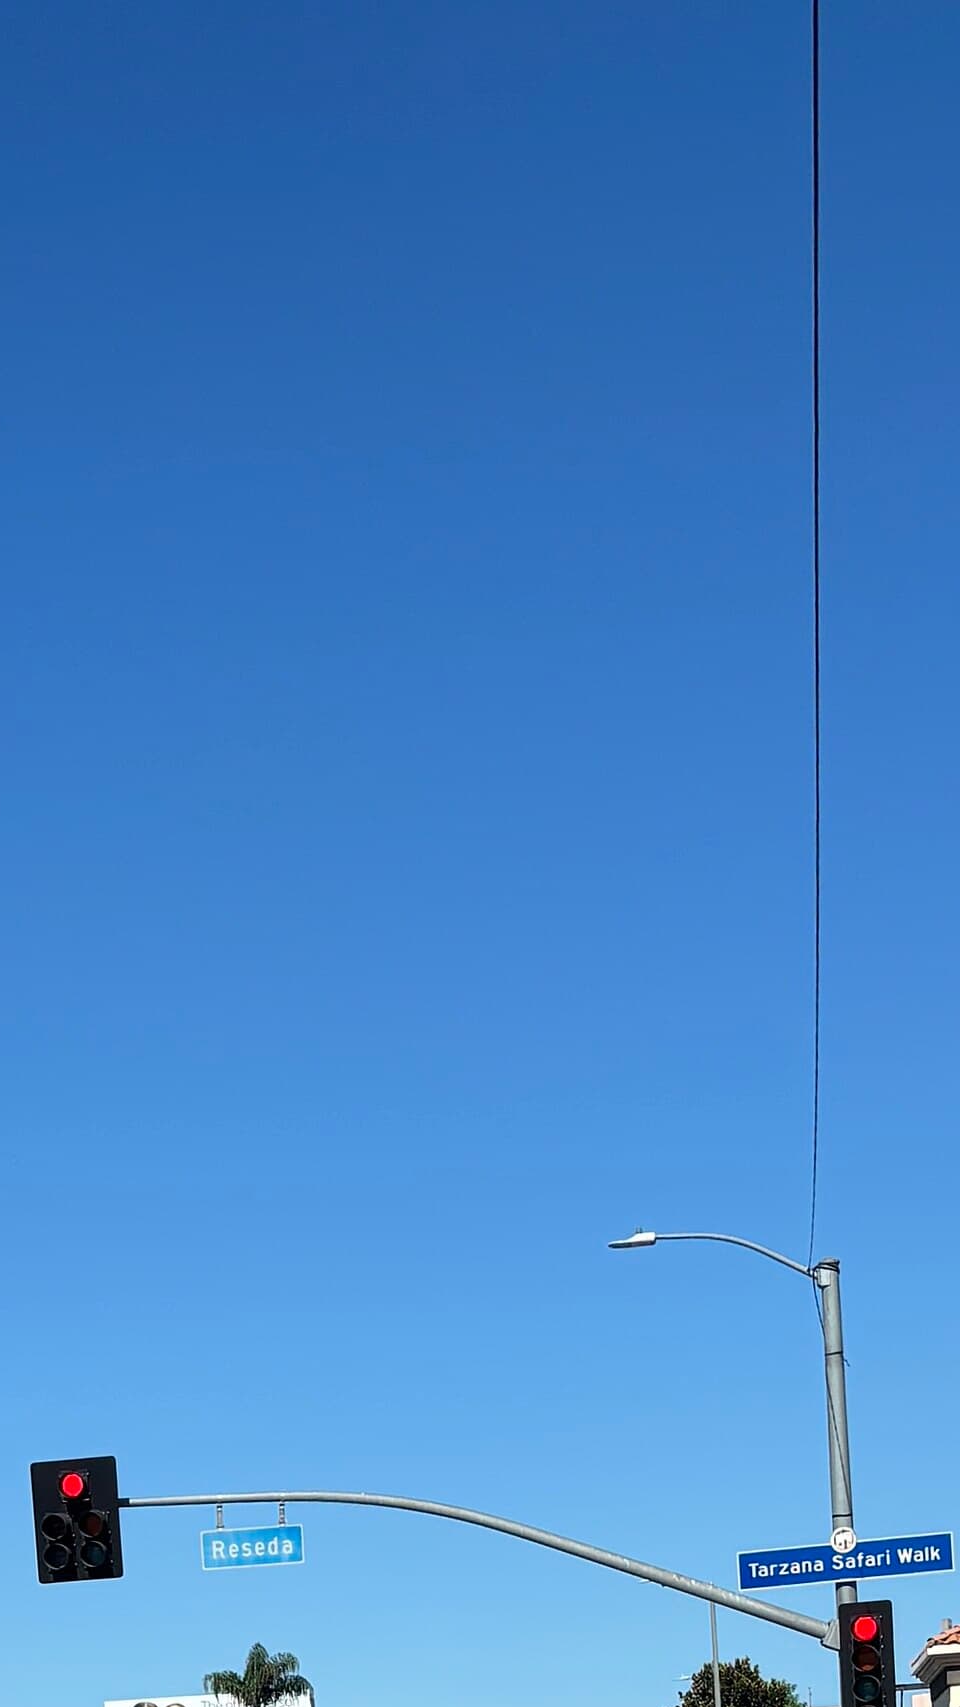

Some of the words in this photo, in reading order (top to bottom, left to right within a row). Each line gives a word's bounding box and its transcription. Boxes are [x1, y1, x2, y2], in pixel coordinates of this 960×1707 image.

[211, 1536, 293, 1559] Reseda
[748, 1559, 824, 1578] Tarzana
[831, 1550, 890, 1570] Safari
[897, 1546, 940, 1564] Walk
